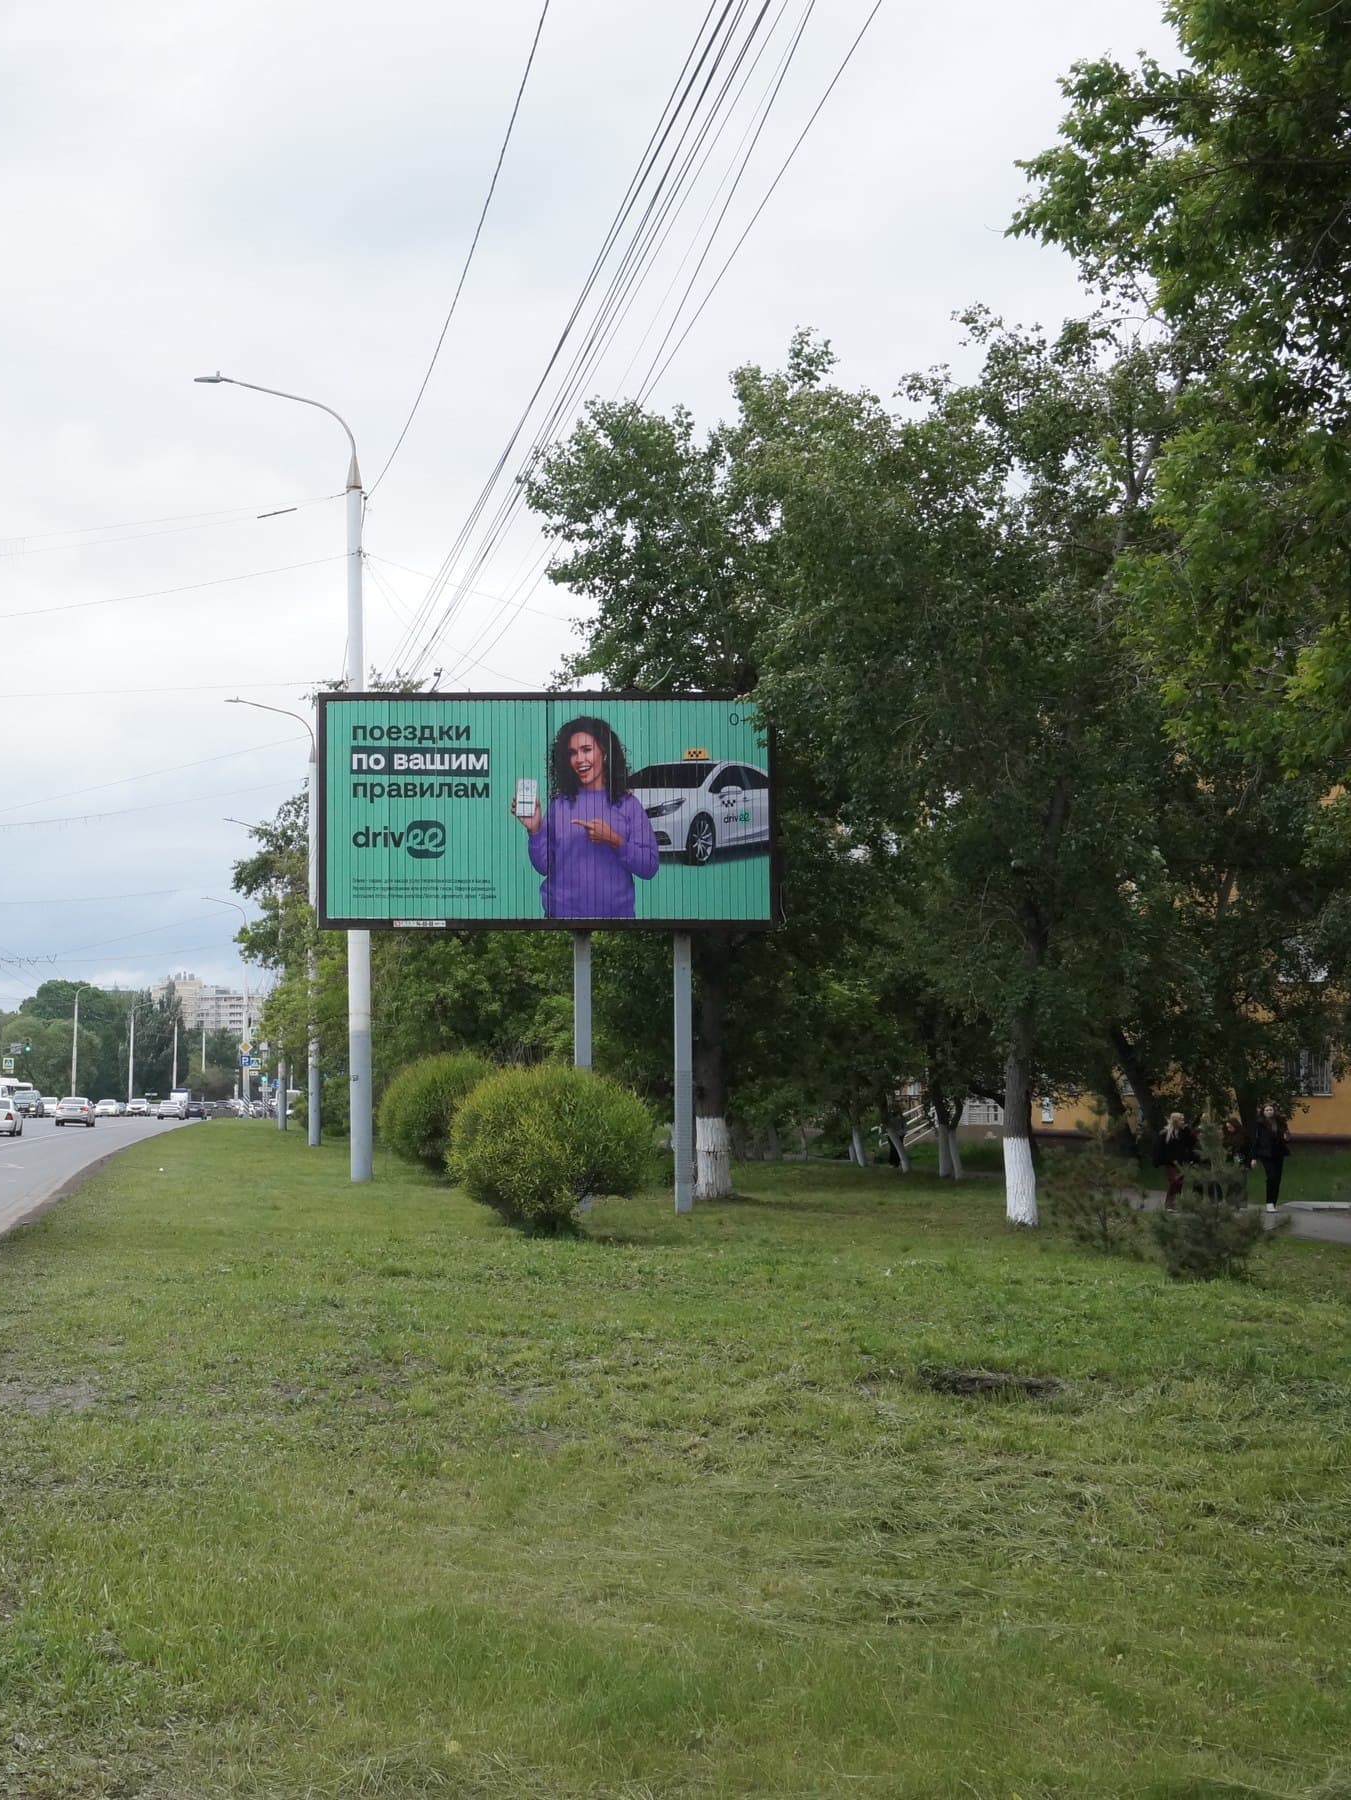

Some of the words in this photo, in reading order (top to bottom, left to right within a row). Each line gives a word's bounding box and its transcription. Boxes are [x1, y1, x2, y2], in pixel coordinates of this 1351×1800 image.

[352, 725, 471, 744] поездки
[352, 753, 386, 770] по
[393, 753, 488, 770] вашим
[352, 782, 490, 804] правилам
[352, 824, 446, 856] drivee
